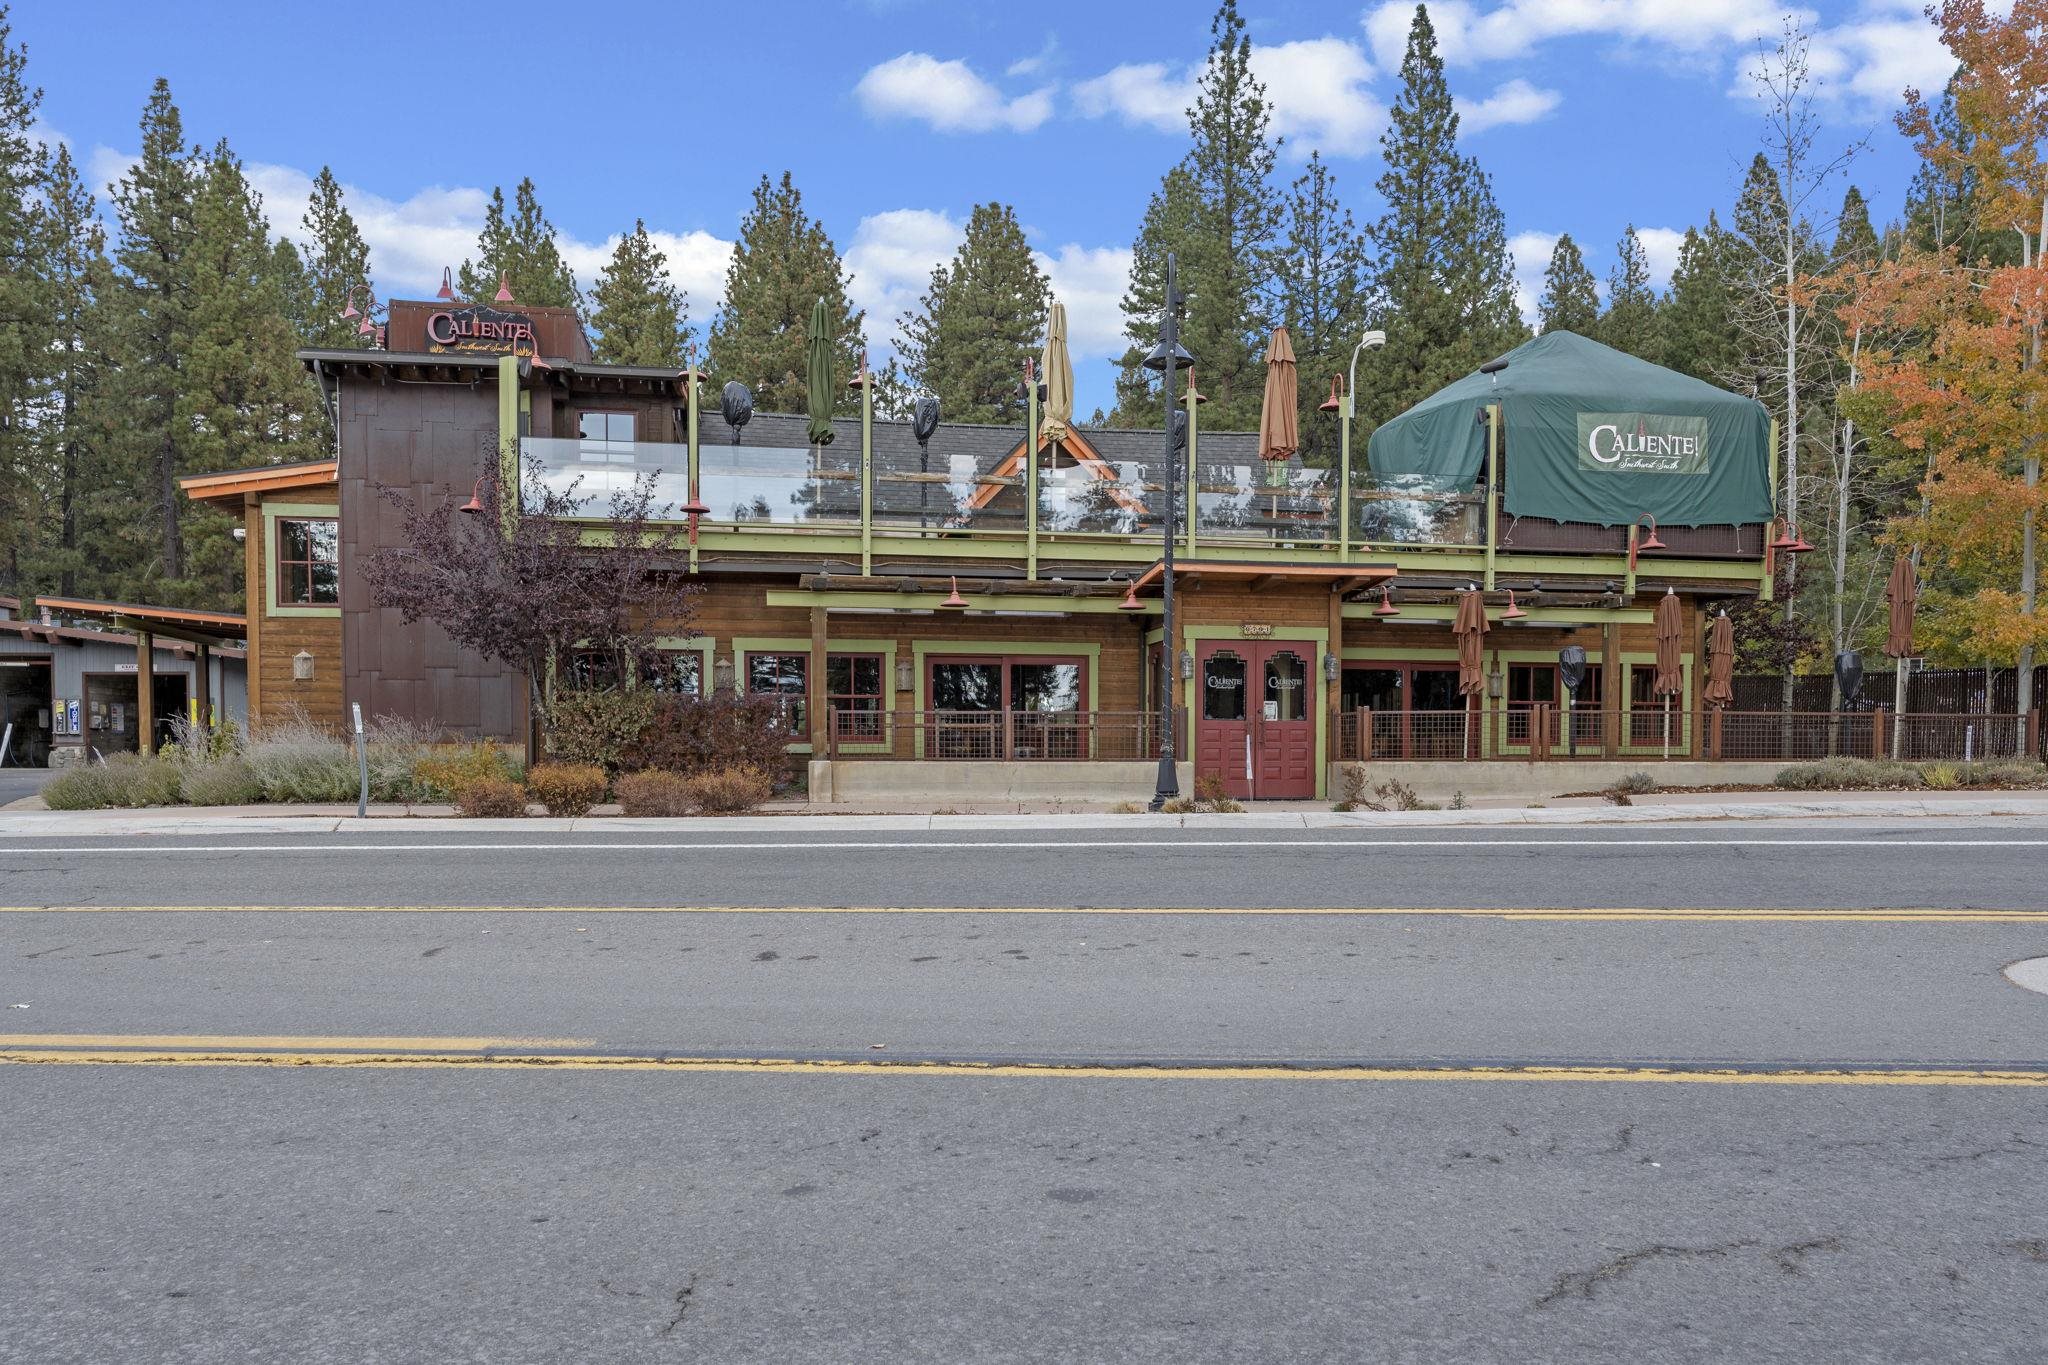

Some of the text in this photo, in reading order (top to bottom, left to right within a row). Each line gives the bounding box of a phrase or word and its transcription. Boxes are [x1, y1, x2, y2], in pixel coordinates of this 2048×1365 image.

[427, 311, 532, 344] CALIENTE!
[1589, 424, 1699, 463] CALIENTE!
[1618, 457, 1680, 470] Southwest South
